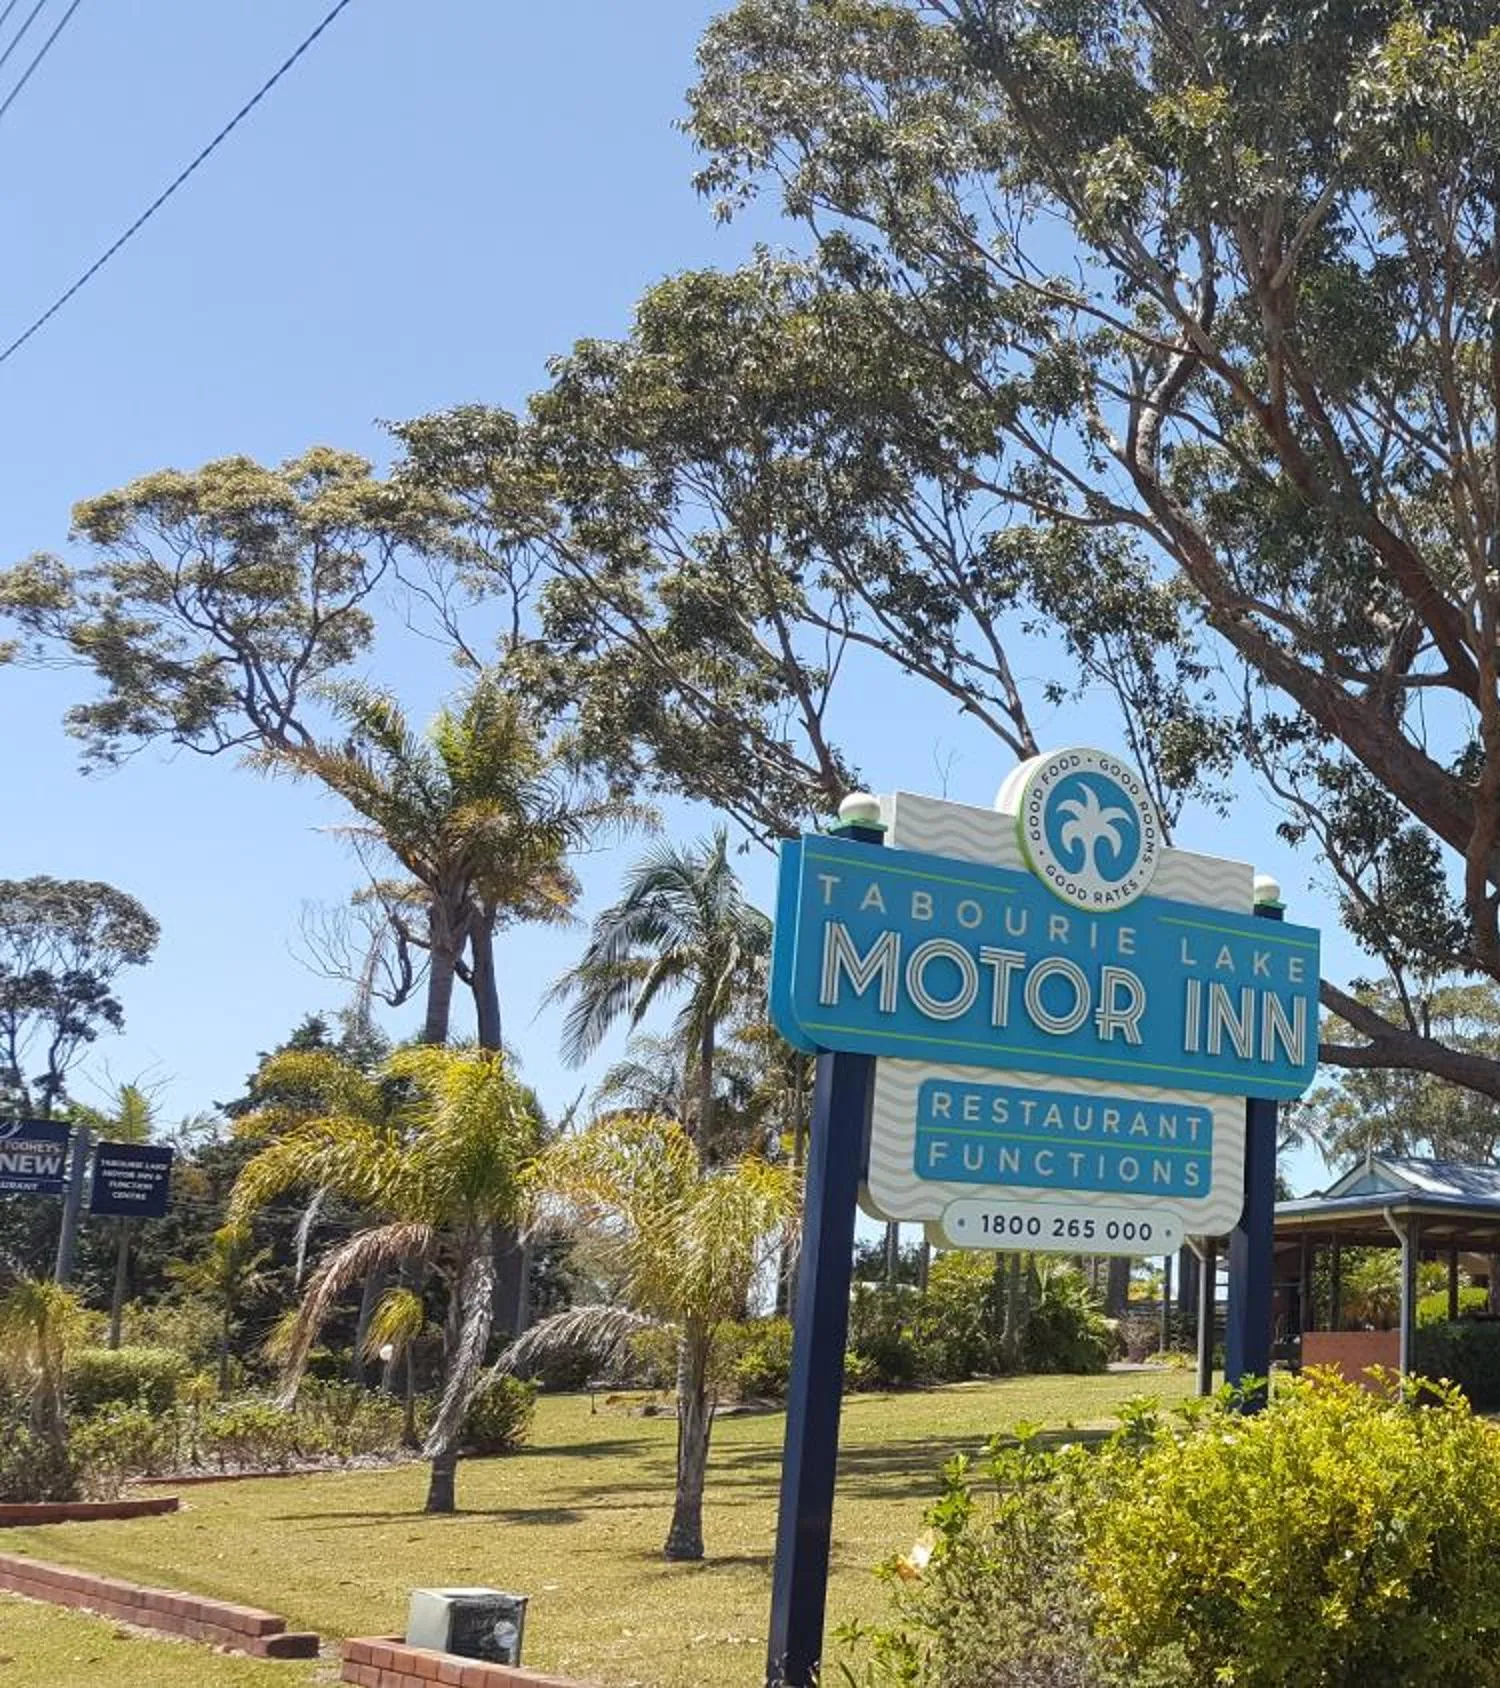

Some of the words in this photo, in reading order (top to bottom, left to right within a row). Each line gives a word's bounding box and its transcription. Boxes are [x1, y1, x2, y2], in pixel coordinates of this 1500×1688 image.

[1029, 788, 1043, 841] GOOD
[1041, 755, 1081, 785] FOOD
[1099, 759, 1140, 795] GOOD
[1137, 801, 1155, 864] ROOMS
[1045, 864, 1087, 901] GOOD
[1094, 879, 1138, 904] RATES
[818, 874, 1138, 954] TABOURIE
[1180, 937, 1305, 984] LAKE
[818, 920, 1147, 1045] MOTOR
[1184, 978, 1307, 1068] INN
[931, 1091, 1202, 1142] RESTAURANT
[0, 1153, 61, 1175] NEW
[929, 1141, 1200, 1187] FUNCTIONS
[981, 1213, 1042, 1237] 1800
[1051, 1216, 1096, 1240] 265
[1106, 1218, 1153, 1242] 000
